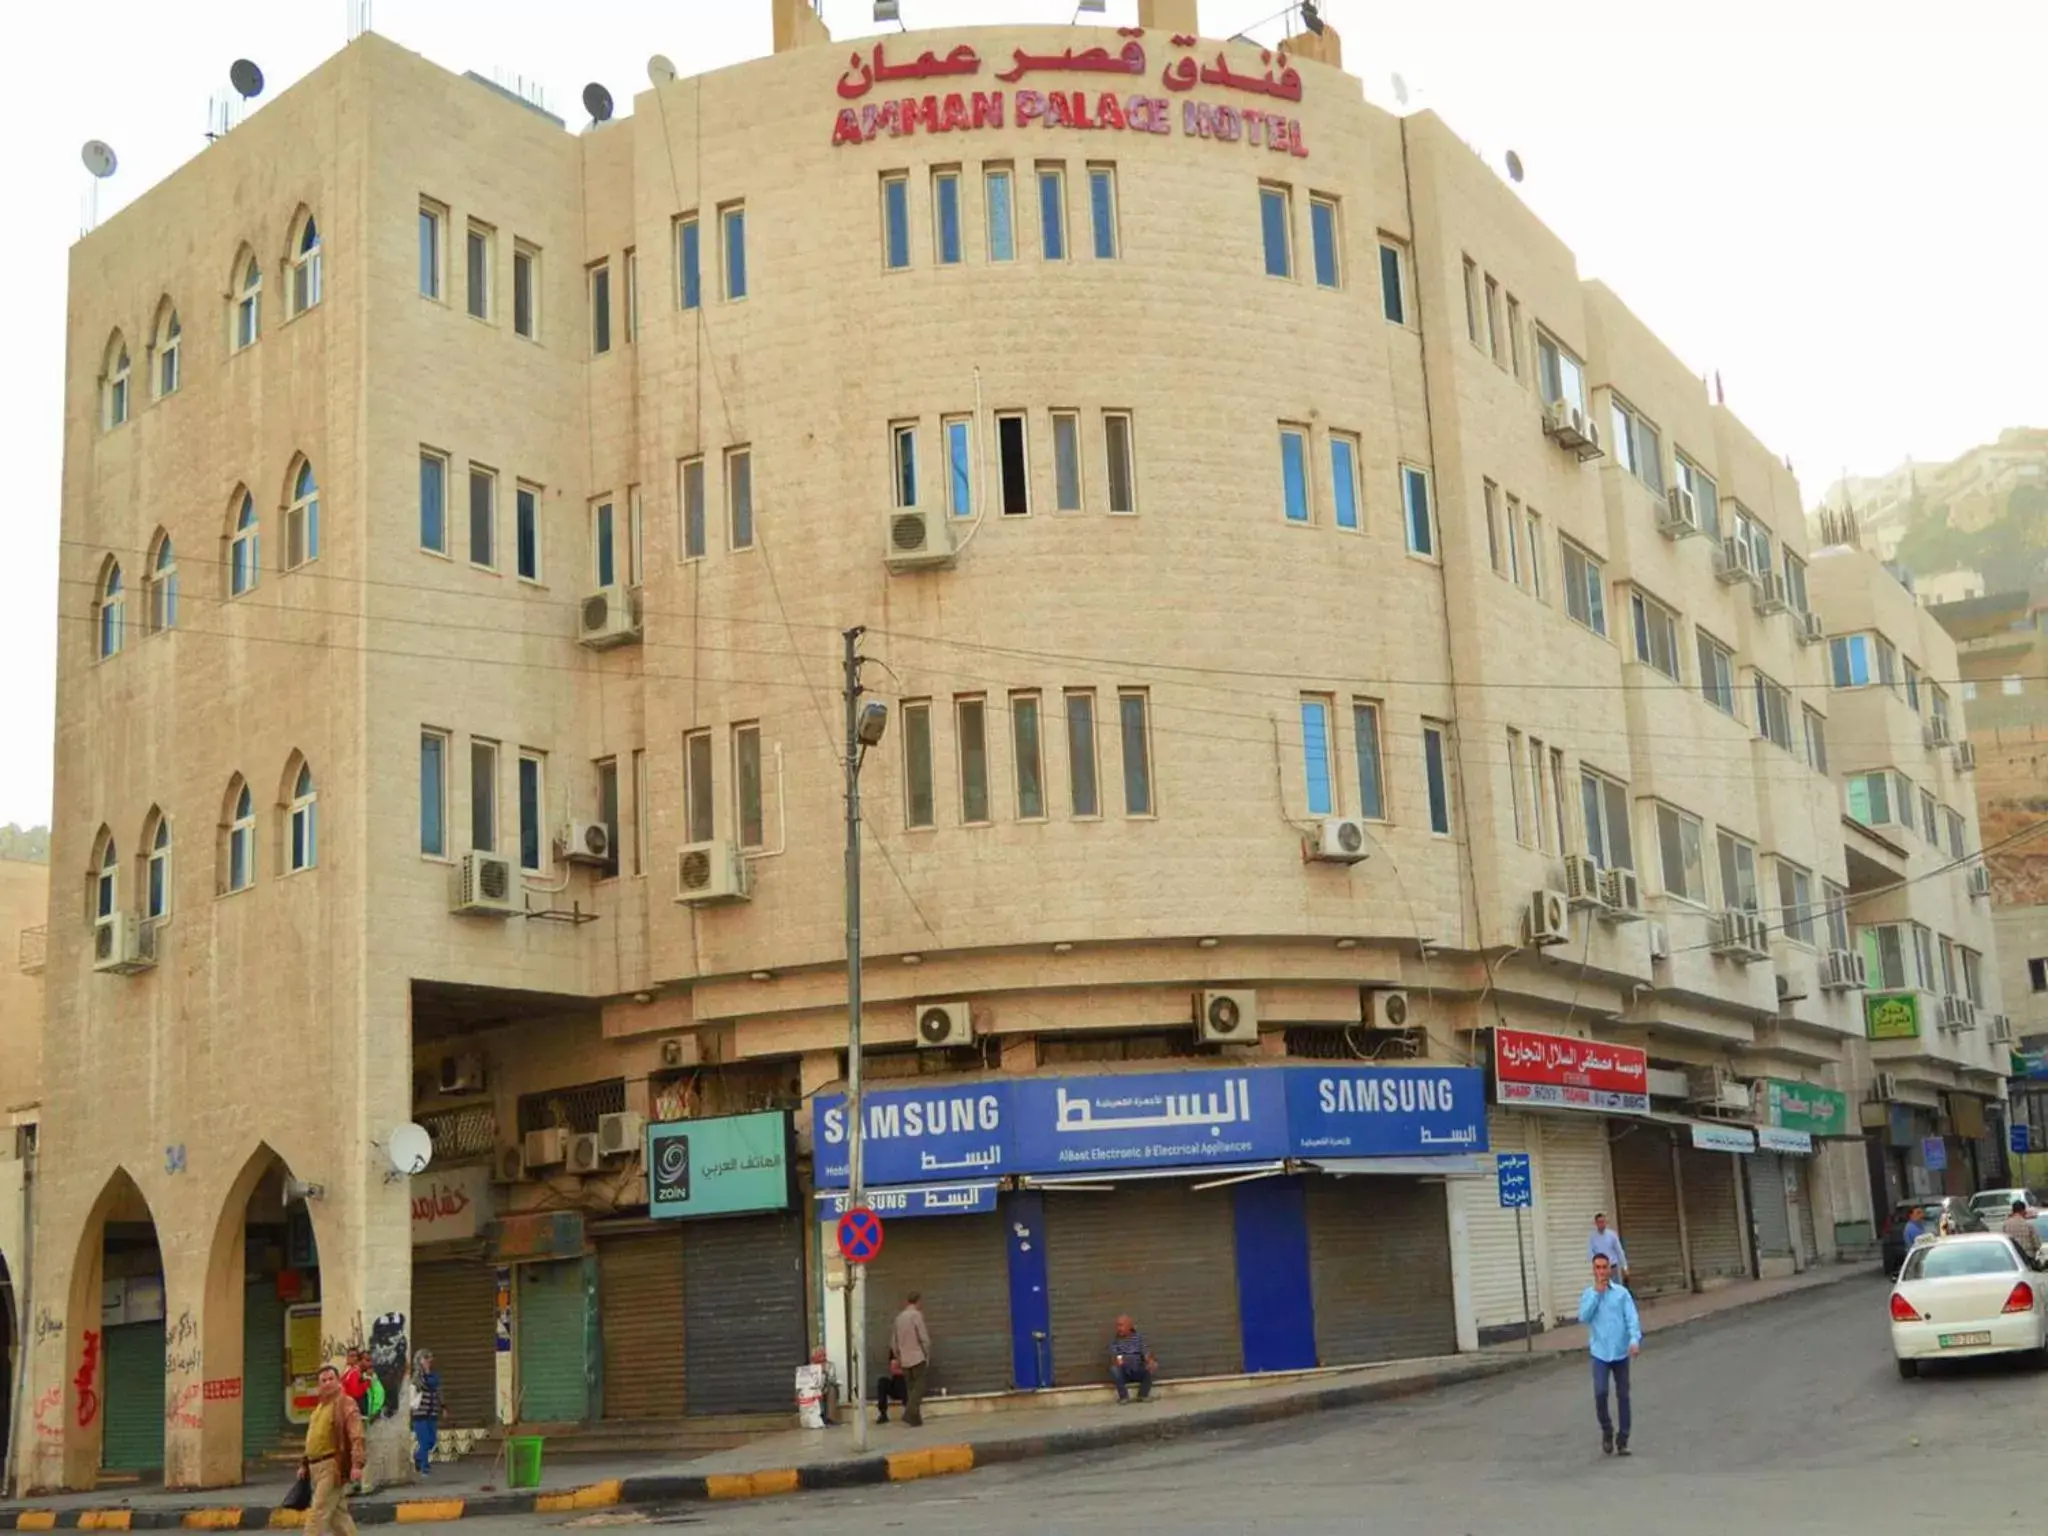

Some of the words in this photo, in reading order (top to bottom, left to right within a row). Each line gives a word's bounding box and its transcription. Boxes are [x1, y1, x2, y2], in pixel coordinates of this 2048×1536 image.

[837, 41, 981, 99] عمان
[994, 27, 1145, 82] قصر
[1162, 34, 1302, 102] فندق
[832, 91, 1004, 146] AMMAN
[1015, 90, 1171, 135] PALACE
[1183, 100, 1309, 158] HOTEL
[1501, 1036, 1545, 1068] التجارية
[1056, 1078, 1250, 1137] البسط
[1319, 1078, 1453, 1113] SAMSUNG
[1091, 1147, 1141, 1160] Electronic
[1145, 1145, 1151, 1157] &
[1153, 1143, 1200, 1157] Electrical
[1201, 1142, 1252, 1156] Appliances
[1420, 1125, 1476, 1147] البسط
[921, 1145, 1001, 1170] البسط
[835, 1193, 907, 1213] SSUNG
[924, 1188, 980, 1209] البسط
